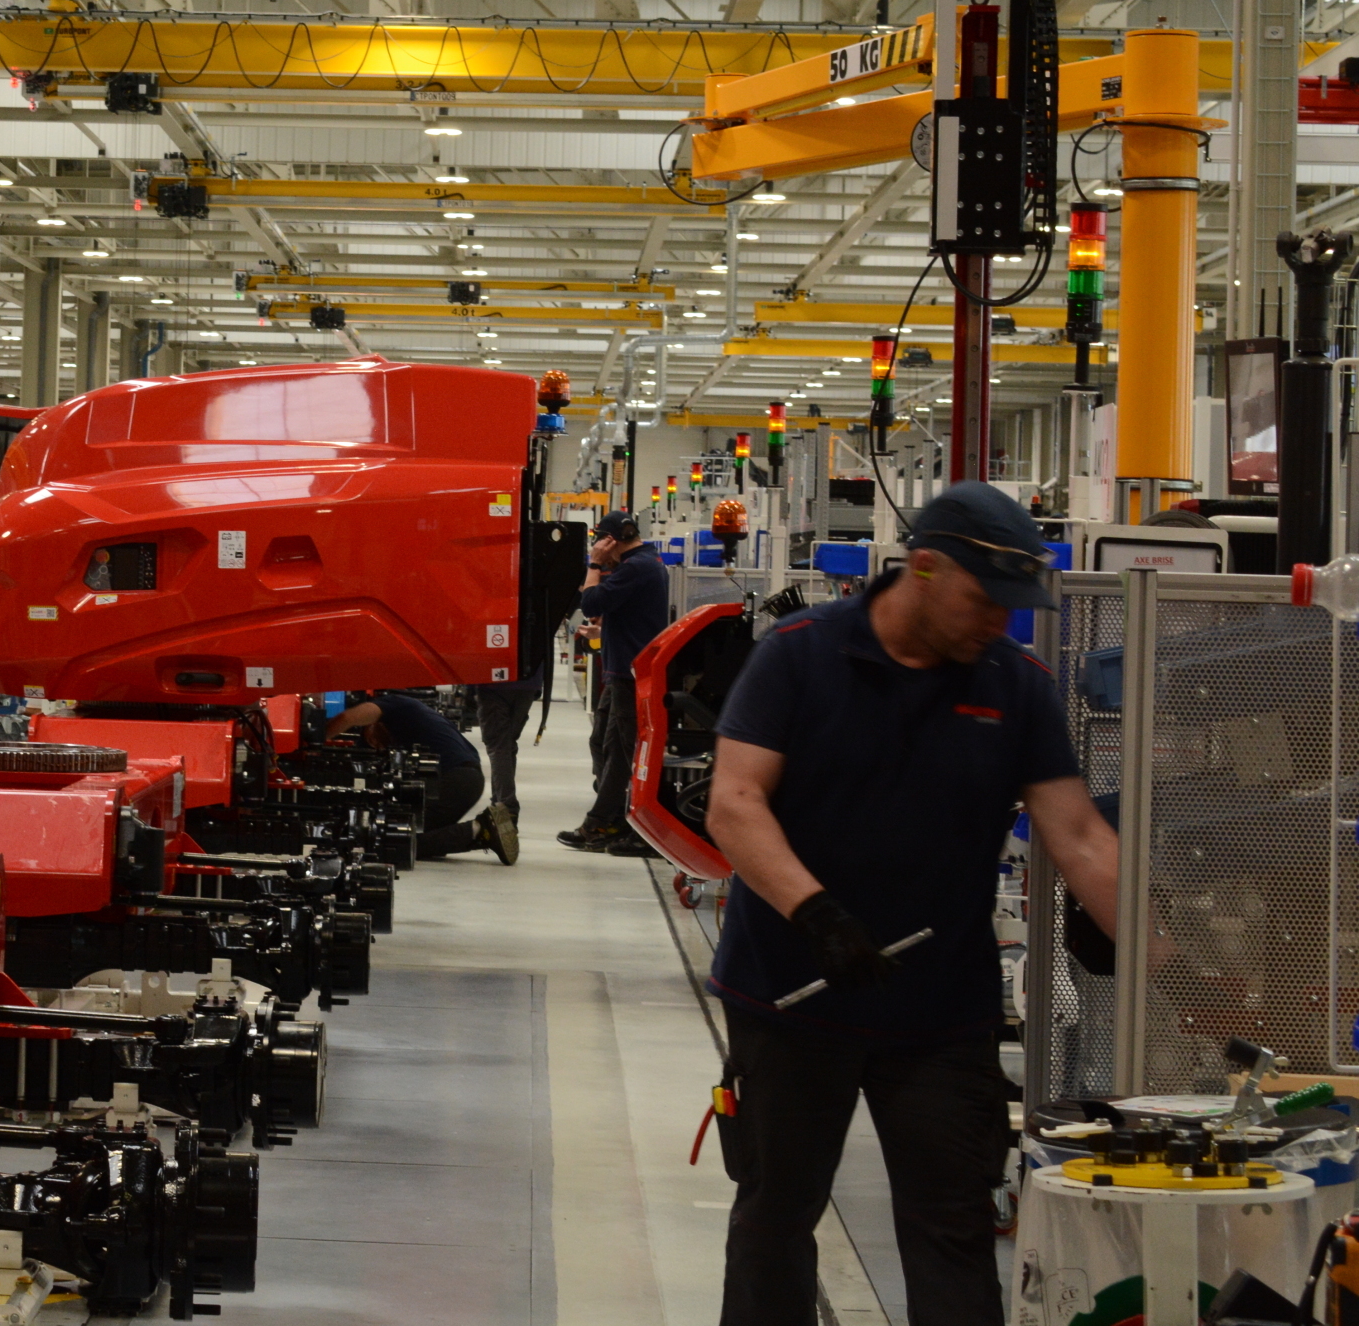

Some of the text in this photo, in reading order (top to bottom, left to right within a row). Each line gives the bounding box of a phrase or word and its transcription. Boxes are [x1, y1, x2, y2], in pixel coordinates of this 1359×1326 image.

[830, 40, 880, 82] 50 KG
[451, 308, 469, 317] 4.0
[1134, 556, 1175, 565] AXE BRISE
